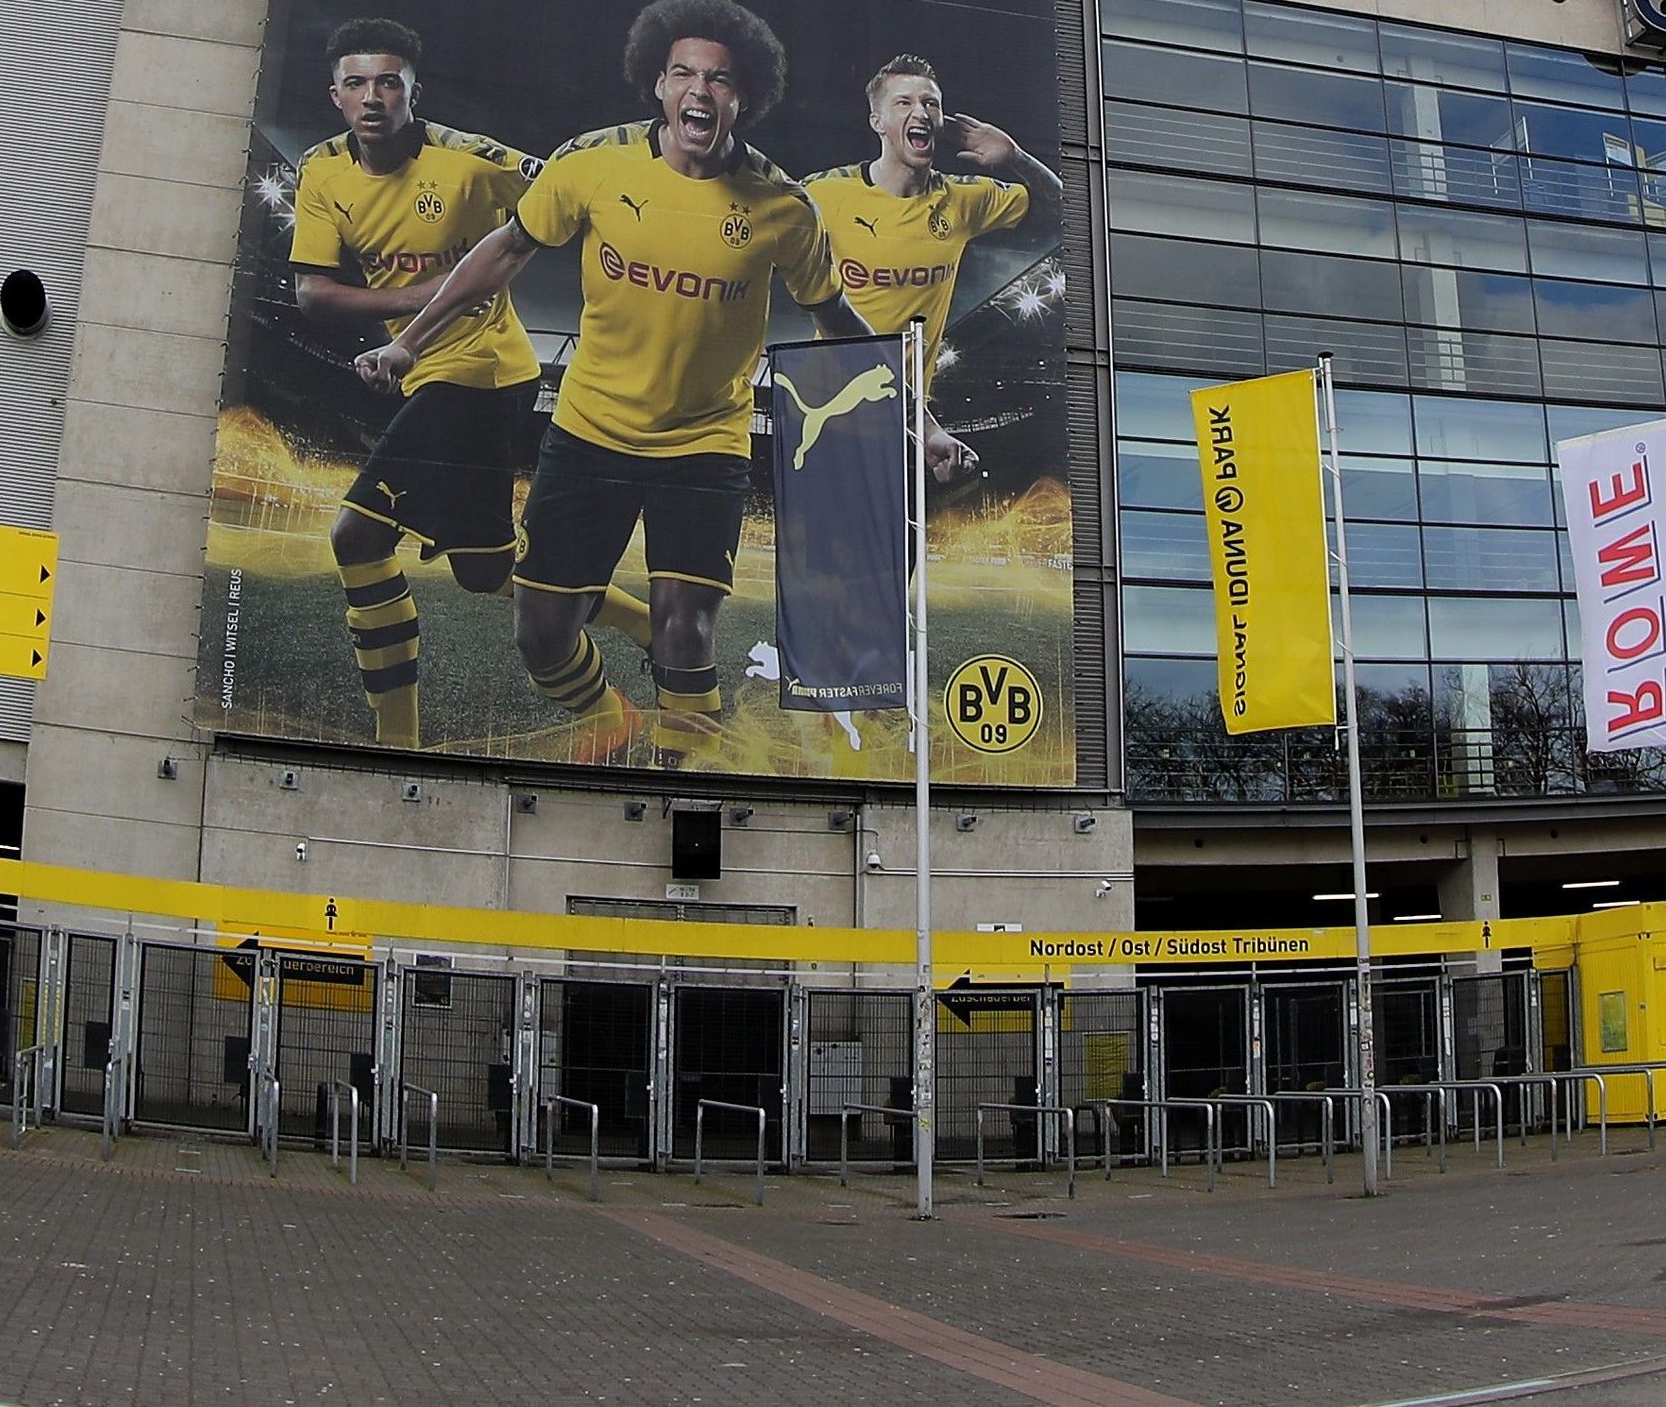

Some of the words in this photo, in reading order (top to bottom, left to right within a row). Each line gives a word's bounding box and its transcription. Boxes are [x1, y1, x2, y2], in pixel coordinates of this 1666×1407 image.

[418, 194, 442, 214] BVB
[724, 216, 750, 241] BVB
[627, 261, 750, 303] EVONIK
[229, 568, 243, 600] REUS
[225, 609, 239, 653] WITSEL
[222, 660, 235, 710] SANCHO
[959, 666, 1031, 725] BVB
[980, 724, 1007, 744] 09
[1030, 939, 1104, 956] Nordost
[1121, 937, 1151, 956] Ost
[1166, 935, 1228, 955] Südost
[1232, 936, 1310, 954] Tribünen
